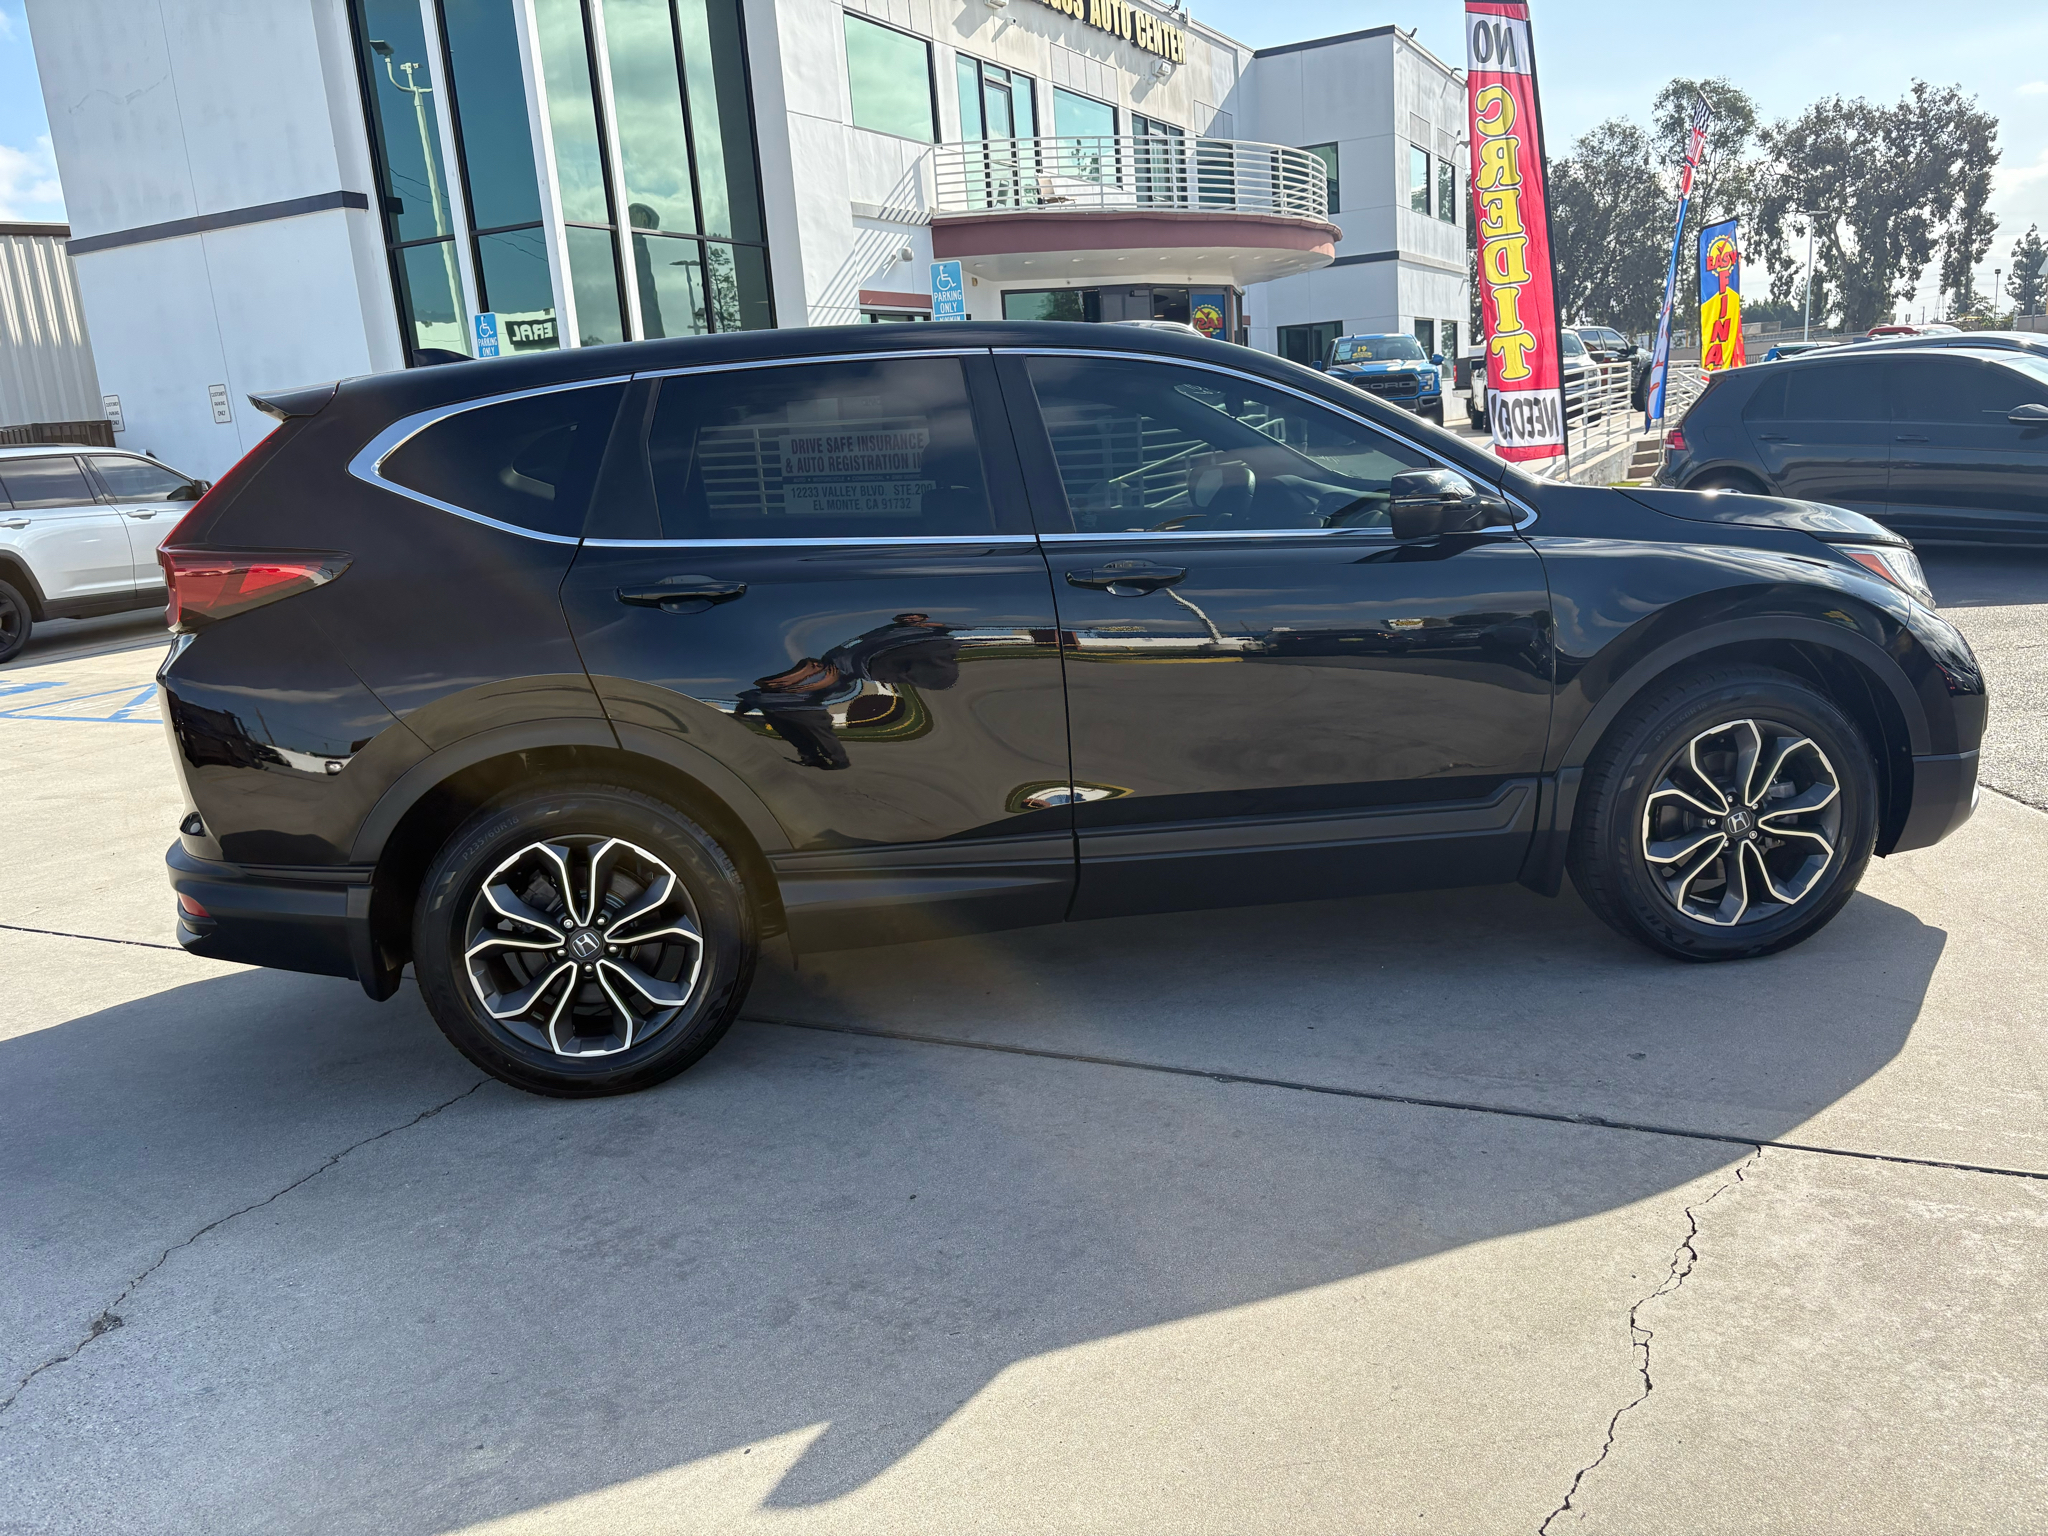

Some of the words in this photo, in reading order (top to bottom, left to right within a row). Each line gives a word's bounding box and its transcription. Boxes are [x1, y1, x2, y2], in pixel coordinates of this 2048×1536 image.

[1089, 0, 1131, 41] AUTO
[1135, 10, 1186, 64] CENTER
[1706, 251, 1738, 272] EASY
[934, 290, 962, 302] PARKING
[940, 302, 957, 313] ONLY
[1703, 269, 1731, 371] FINA
[477, 336, 498, 348] PARKING
[482, 346, 495, 357] ONLY
[1356, 380, 1416, 390] FORD
[791, 438, 823, 454] DRIVE
[826, 436, 854, 453] SAFE
[857, 433, 924, 452] INSURANCE
[785, 457, 794, 474] &
[797, 456, 825, 473] AUTO
[828, 453, 909, 472] REGISTRATION
[791, 486, 819, 499] 12233
[822, 485, 857, 498] VALLEY
[813, 500, 825, 511] EL
[827, 499, 864, 512] MONTE,
[866, 498, 879, 510] CA
[881, 497, 911, 510] 91732
